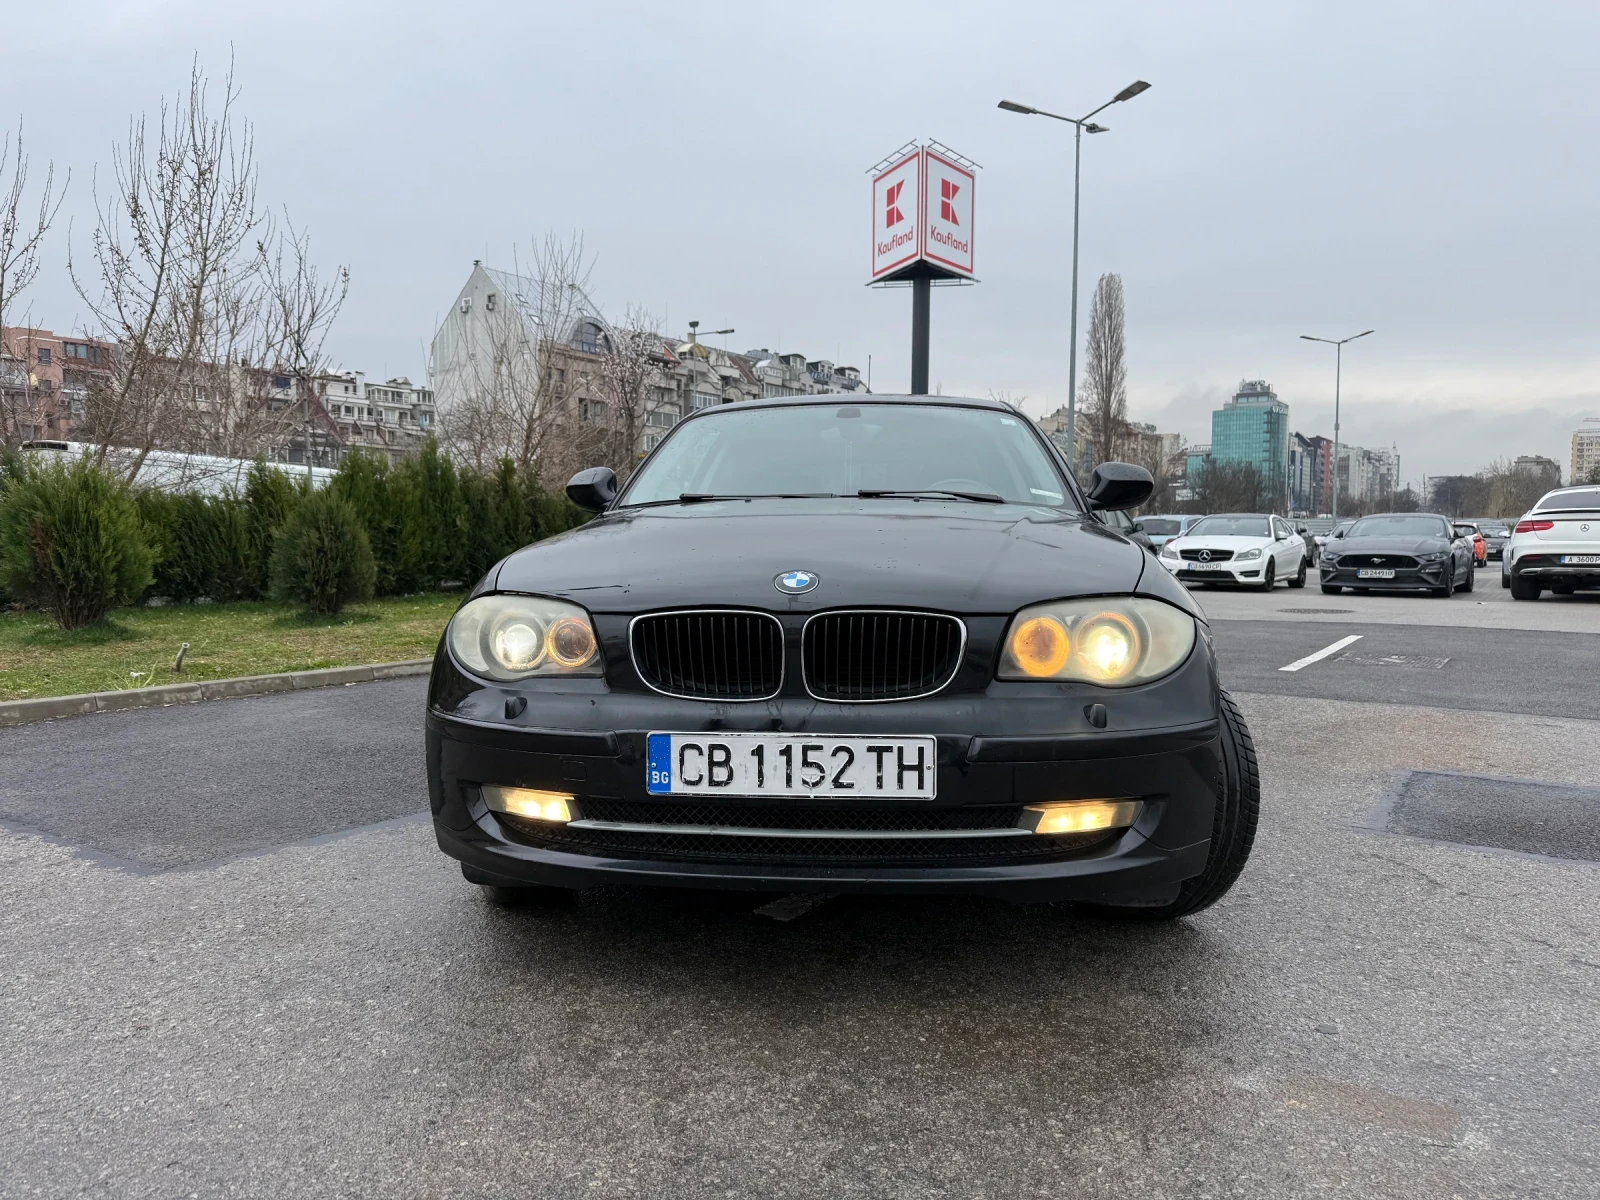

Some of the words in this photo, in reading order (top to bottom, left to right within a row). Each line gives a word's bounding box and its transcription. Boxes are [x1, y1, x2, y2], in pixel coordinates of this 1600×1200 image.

[877, 226, 914, 257] Kaufland
[930, 225, 969, 254] Kaufland
[652, 771, 669, 784] BG
[678, 743, 734, 787] CB
[750, 744, 855, 789] 1152
[866, 745, 925, 790] TH
